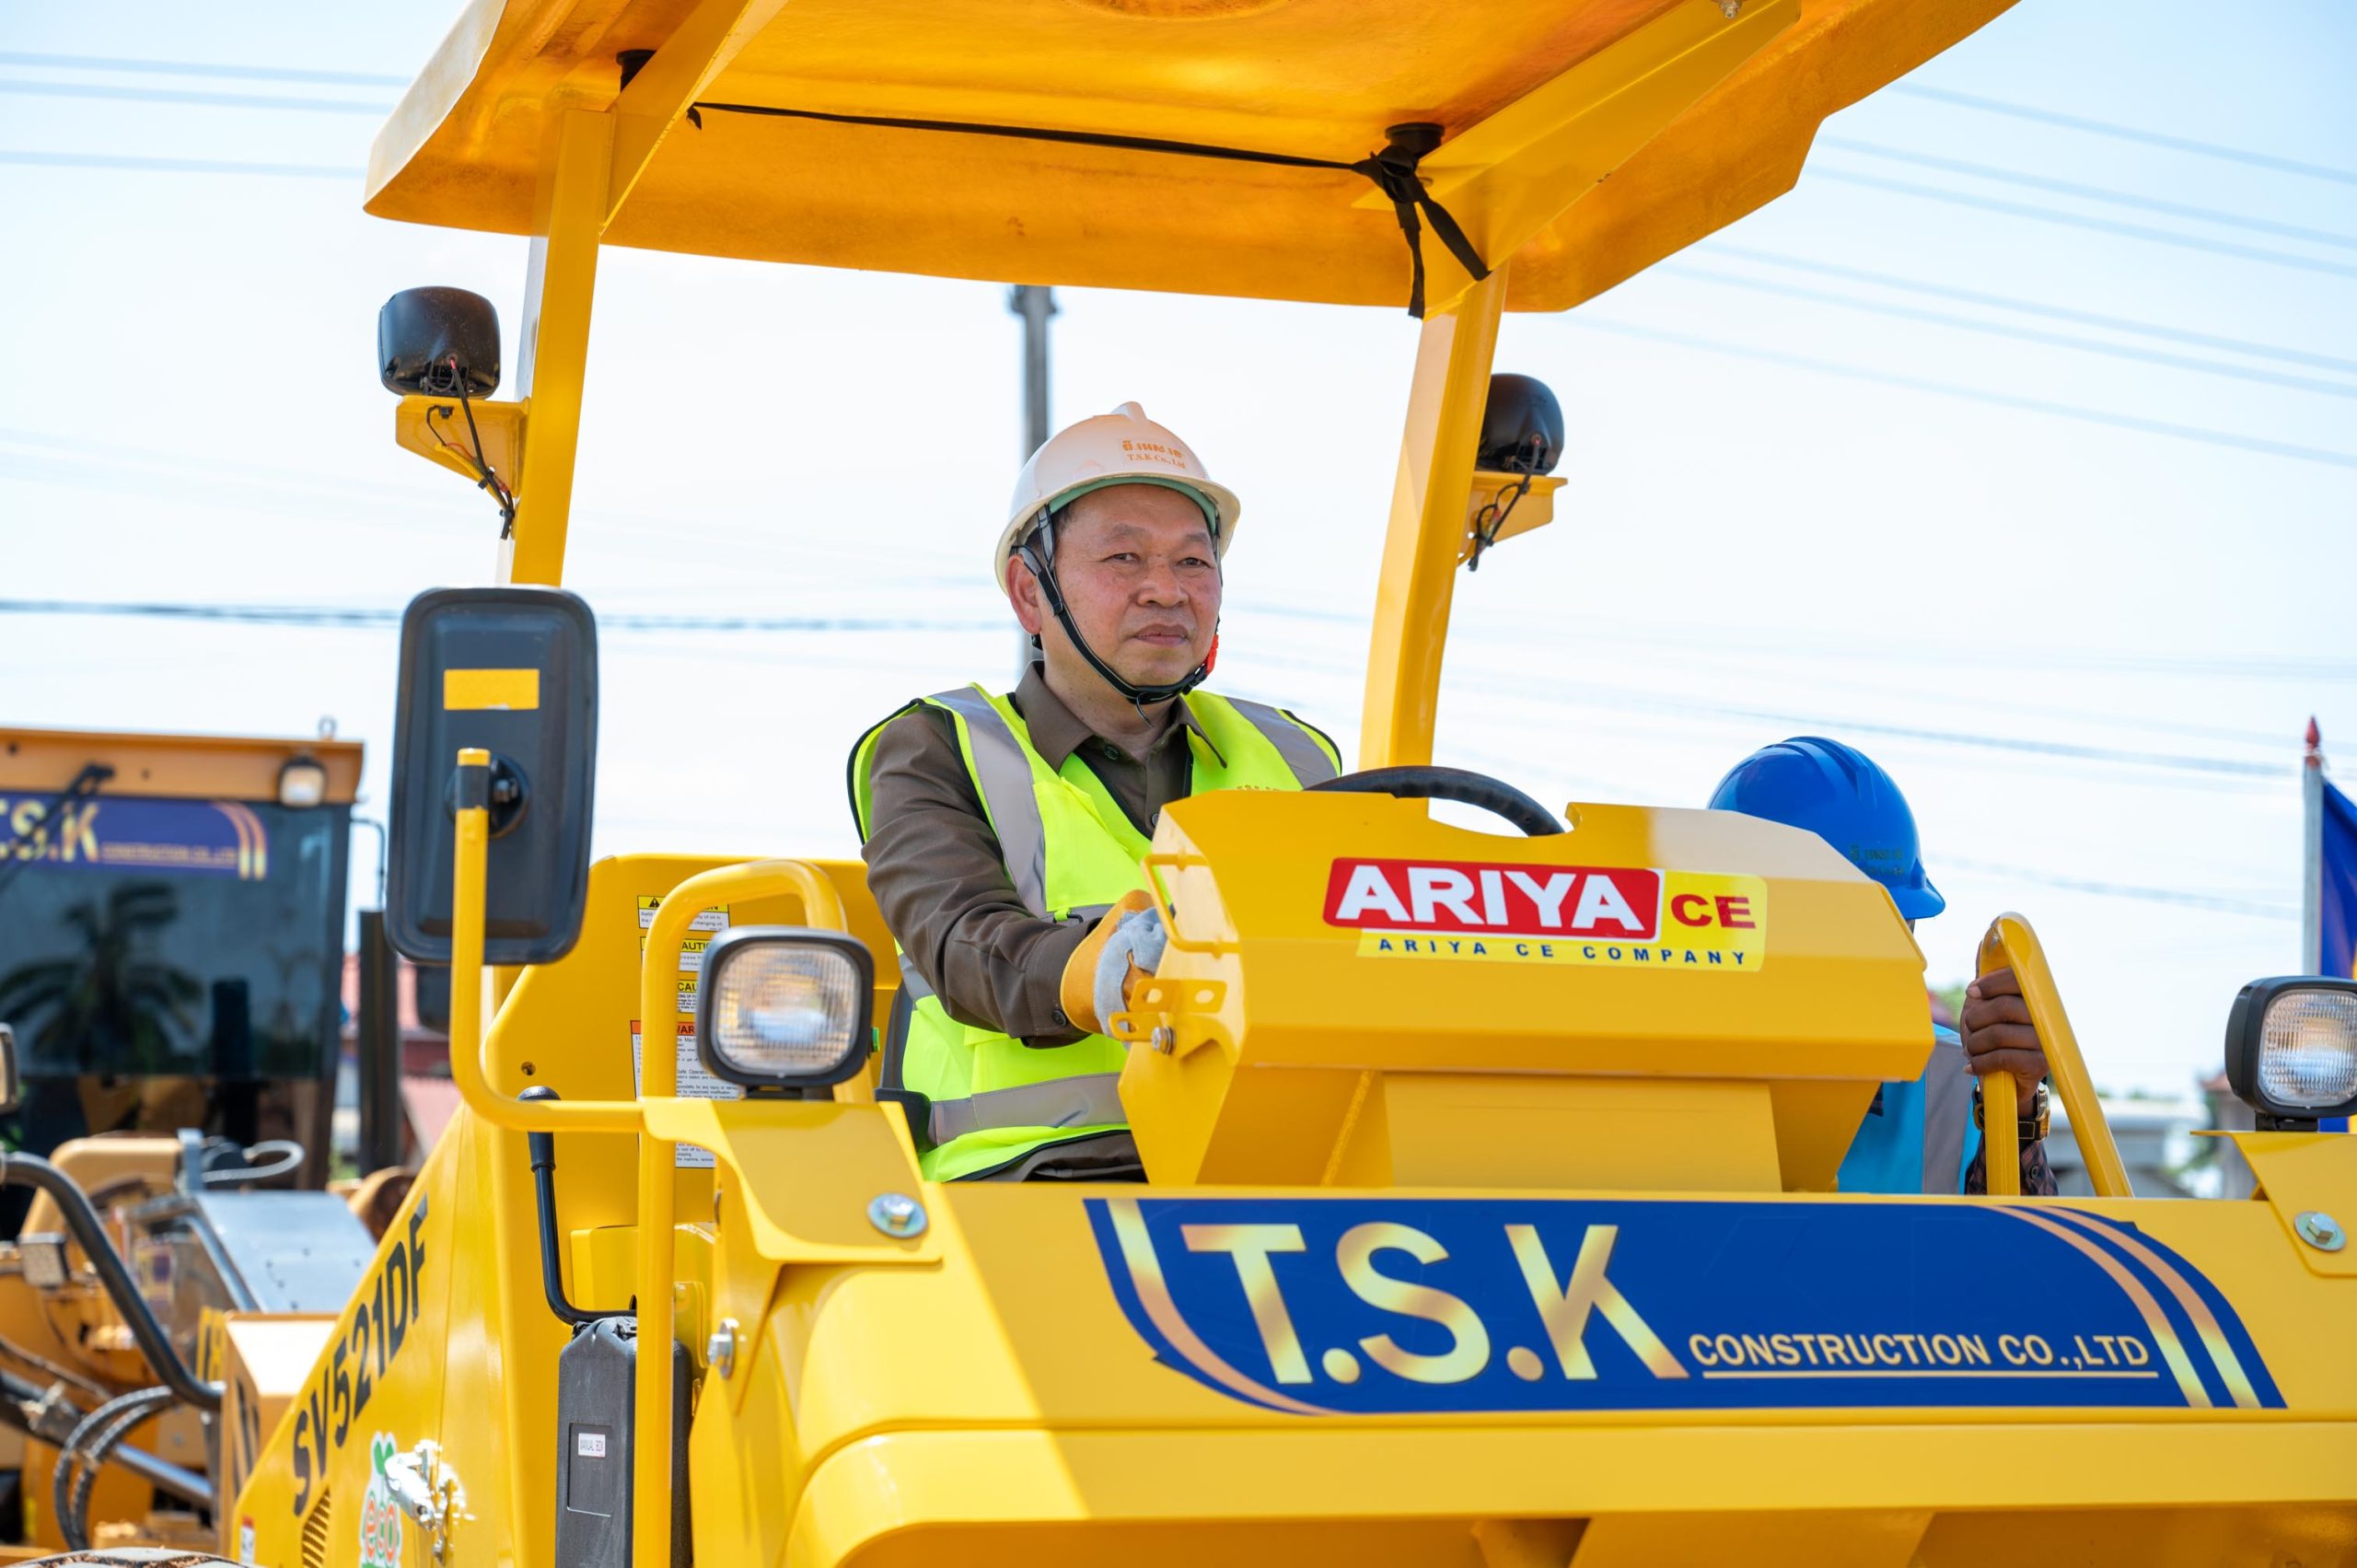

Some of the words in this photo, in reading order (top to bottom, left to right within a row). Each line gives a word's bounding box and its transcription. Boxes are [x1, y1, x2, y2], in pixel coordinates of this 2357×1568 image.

[0, 798, 99, 863] .S.K
[1335, 865, 1644, 930] ARIYA
[1669, 894, 1757, 929] CE
[1379, 938, 1487, 955] ARIYA
[1516, 944, 1554, 958] CE
[1583, 946, 1745, 965] COMPANY
[1179, 1221, 1690, 1384] T.S.K
[1689, 1333, 1992, 1366] CONSTRUCTION
[292, 1192, 428, 1517] SV521DF
